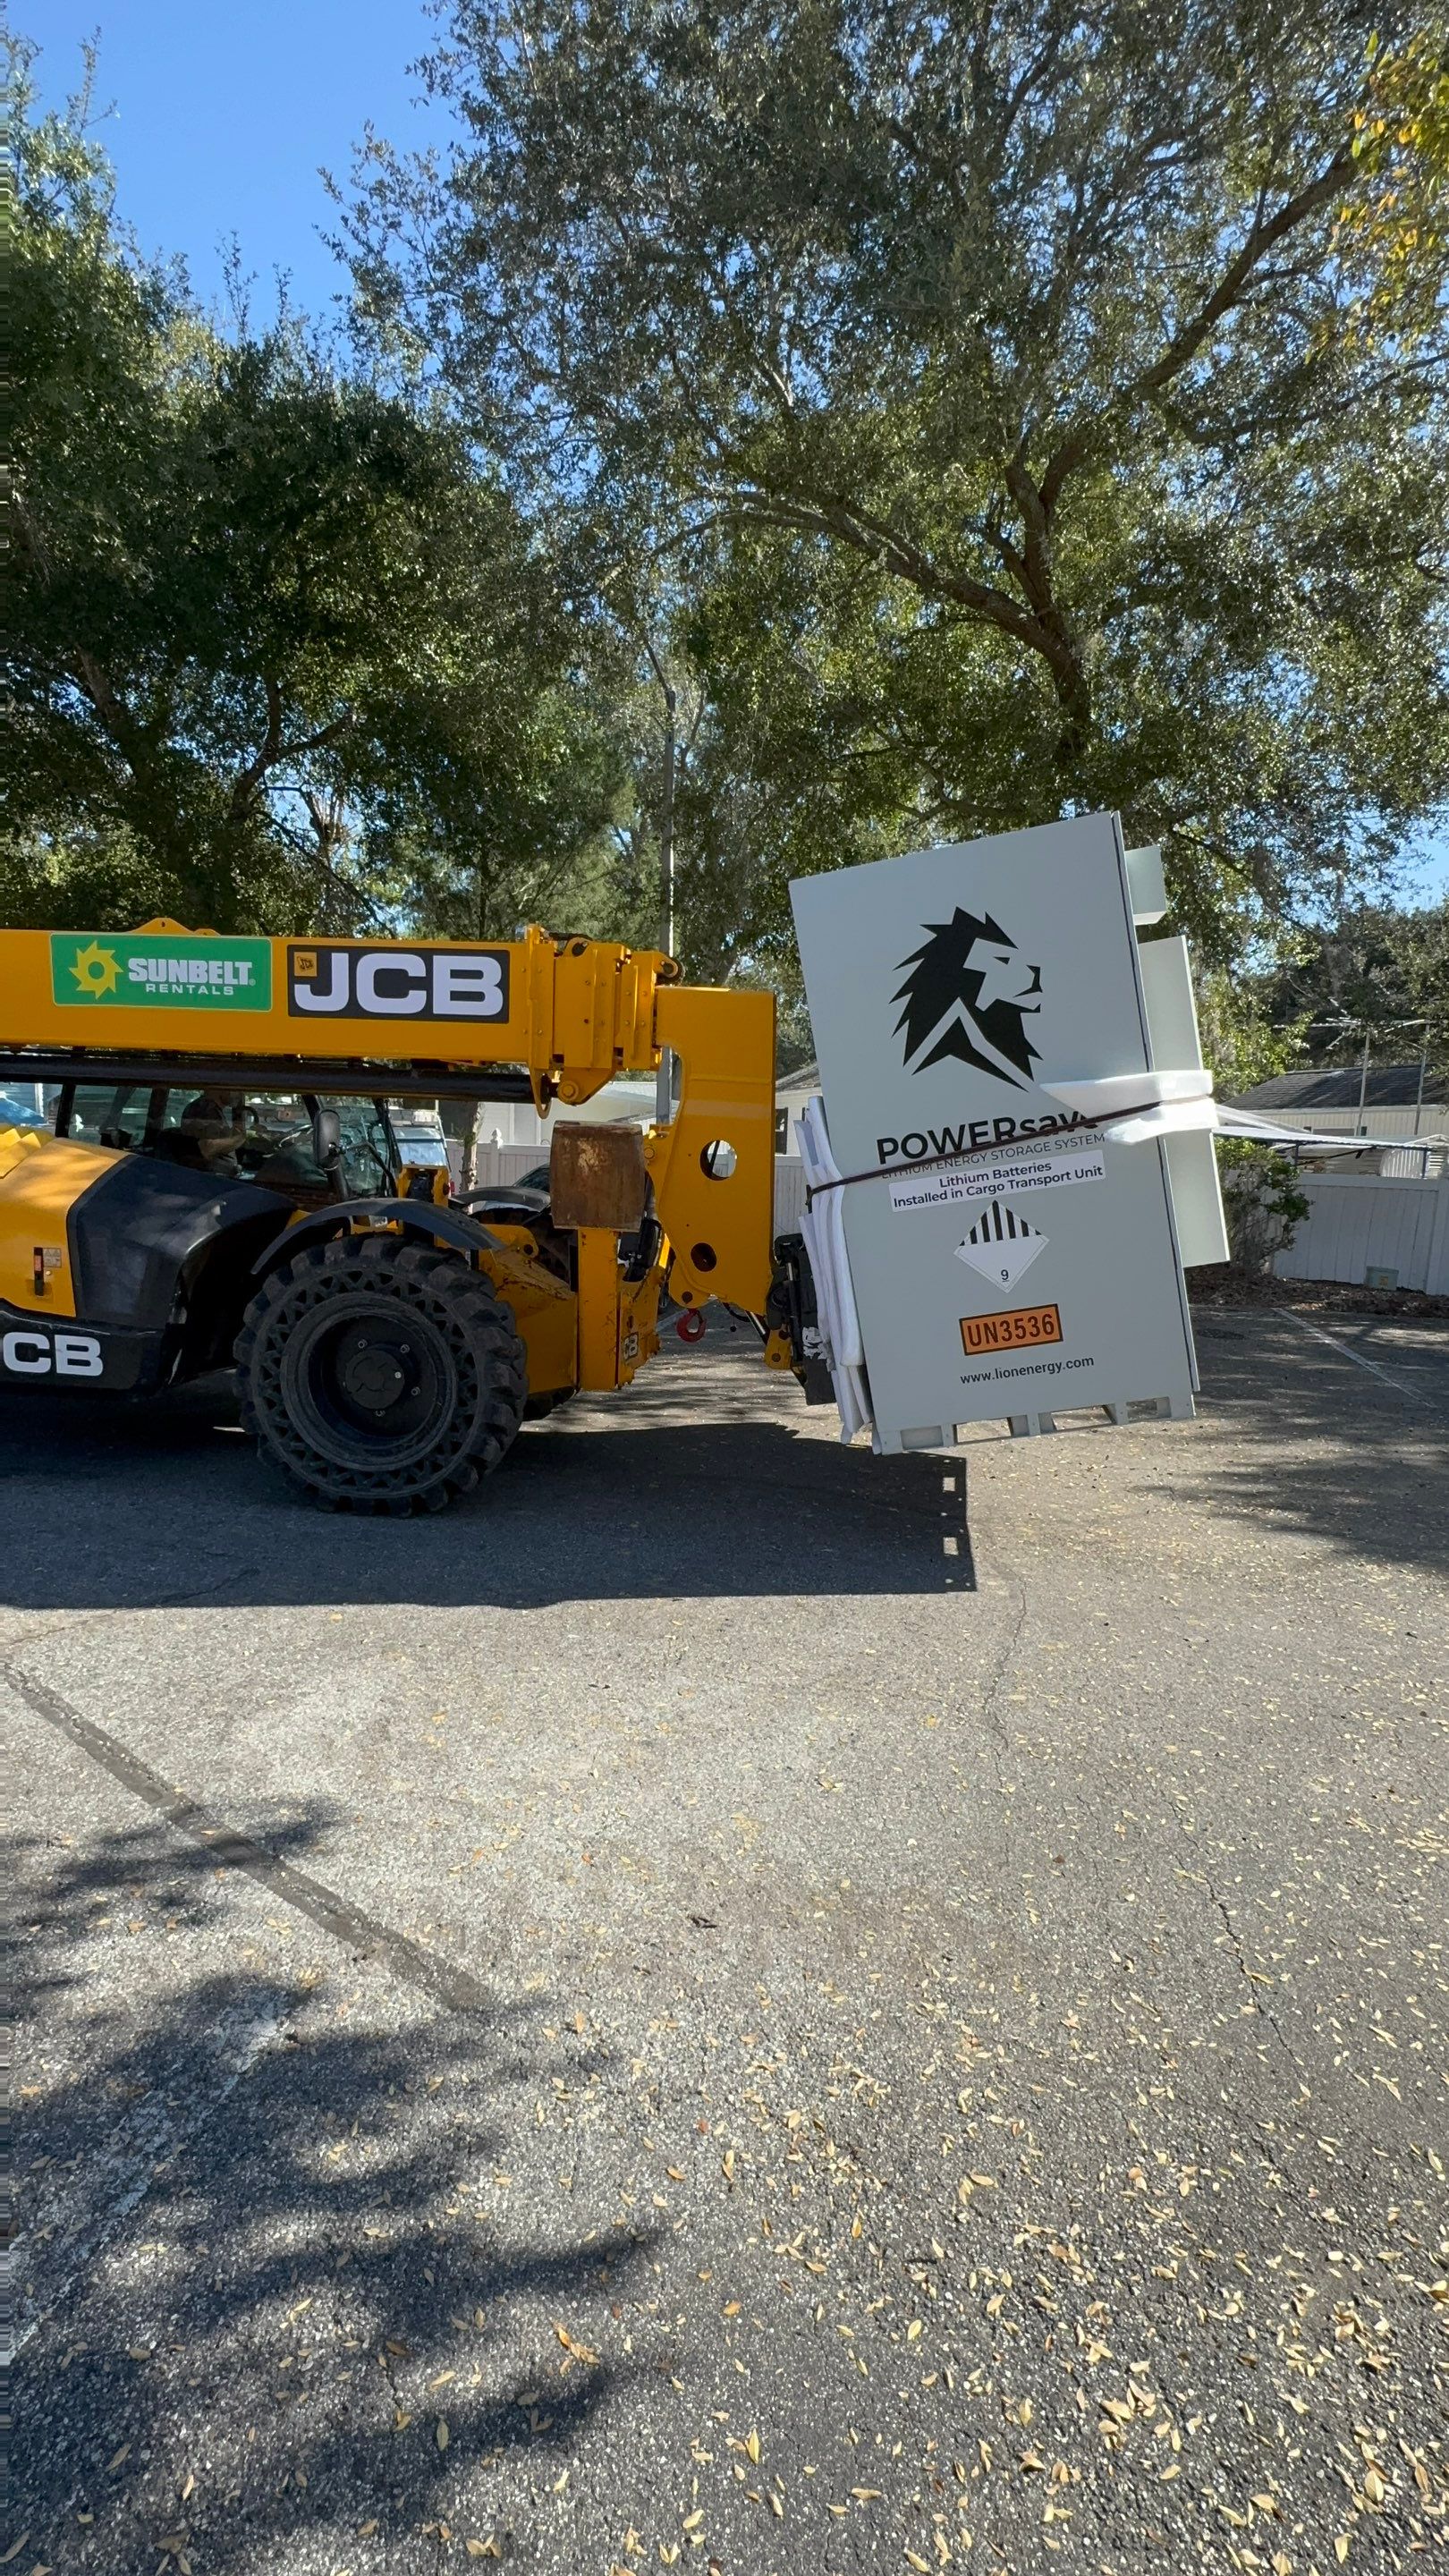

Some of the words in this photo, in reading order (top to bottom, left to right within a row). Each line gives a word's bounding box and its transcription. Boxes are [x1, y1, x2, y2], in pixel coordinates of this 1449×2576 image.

[128, 957, 252, 986] SUNBELT
[294, 952, 504, 1016] JCB
[145, 983, 234, 996] RENTALS
[877, 1111, 1098, 1165] POWERsav
[936, 1152, 988, 1170] ENERGY
[991, 1140, 1052, 1161] STORAGE
[1055, 1132, 1106, 1150] SYSTEM
[894, 1189, 948, 1208] Installed
[951, 1188, 963, 1199] in
[966, 1182, 1005, 1199] Cargo
[1006, 1171, 1072, 1191] Transport
[1074, 1165, 1104, 1179] Unit
[939, 1171, 990, 1188] Lithium
[993, 1161, 1053, 1180] Batteries
[1000, 1268, 1010, 1282] 9
[967, 1313, 1055, 1347] UN3536
[0, 1331, 104, 1377] CB
[960, 1356, 1095, 1385] www.lionenergy.com
